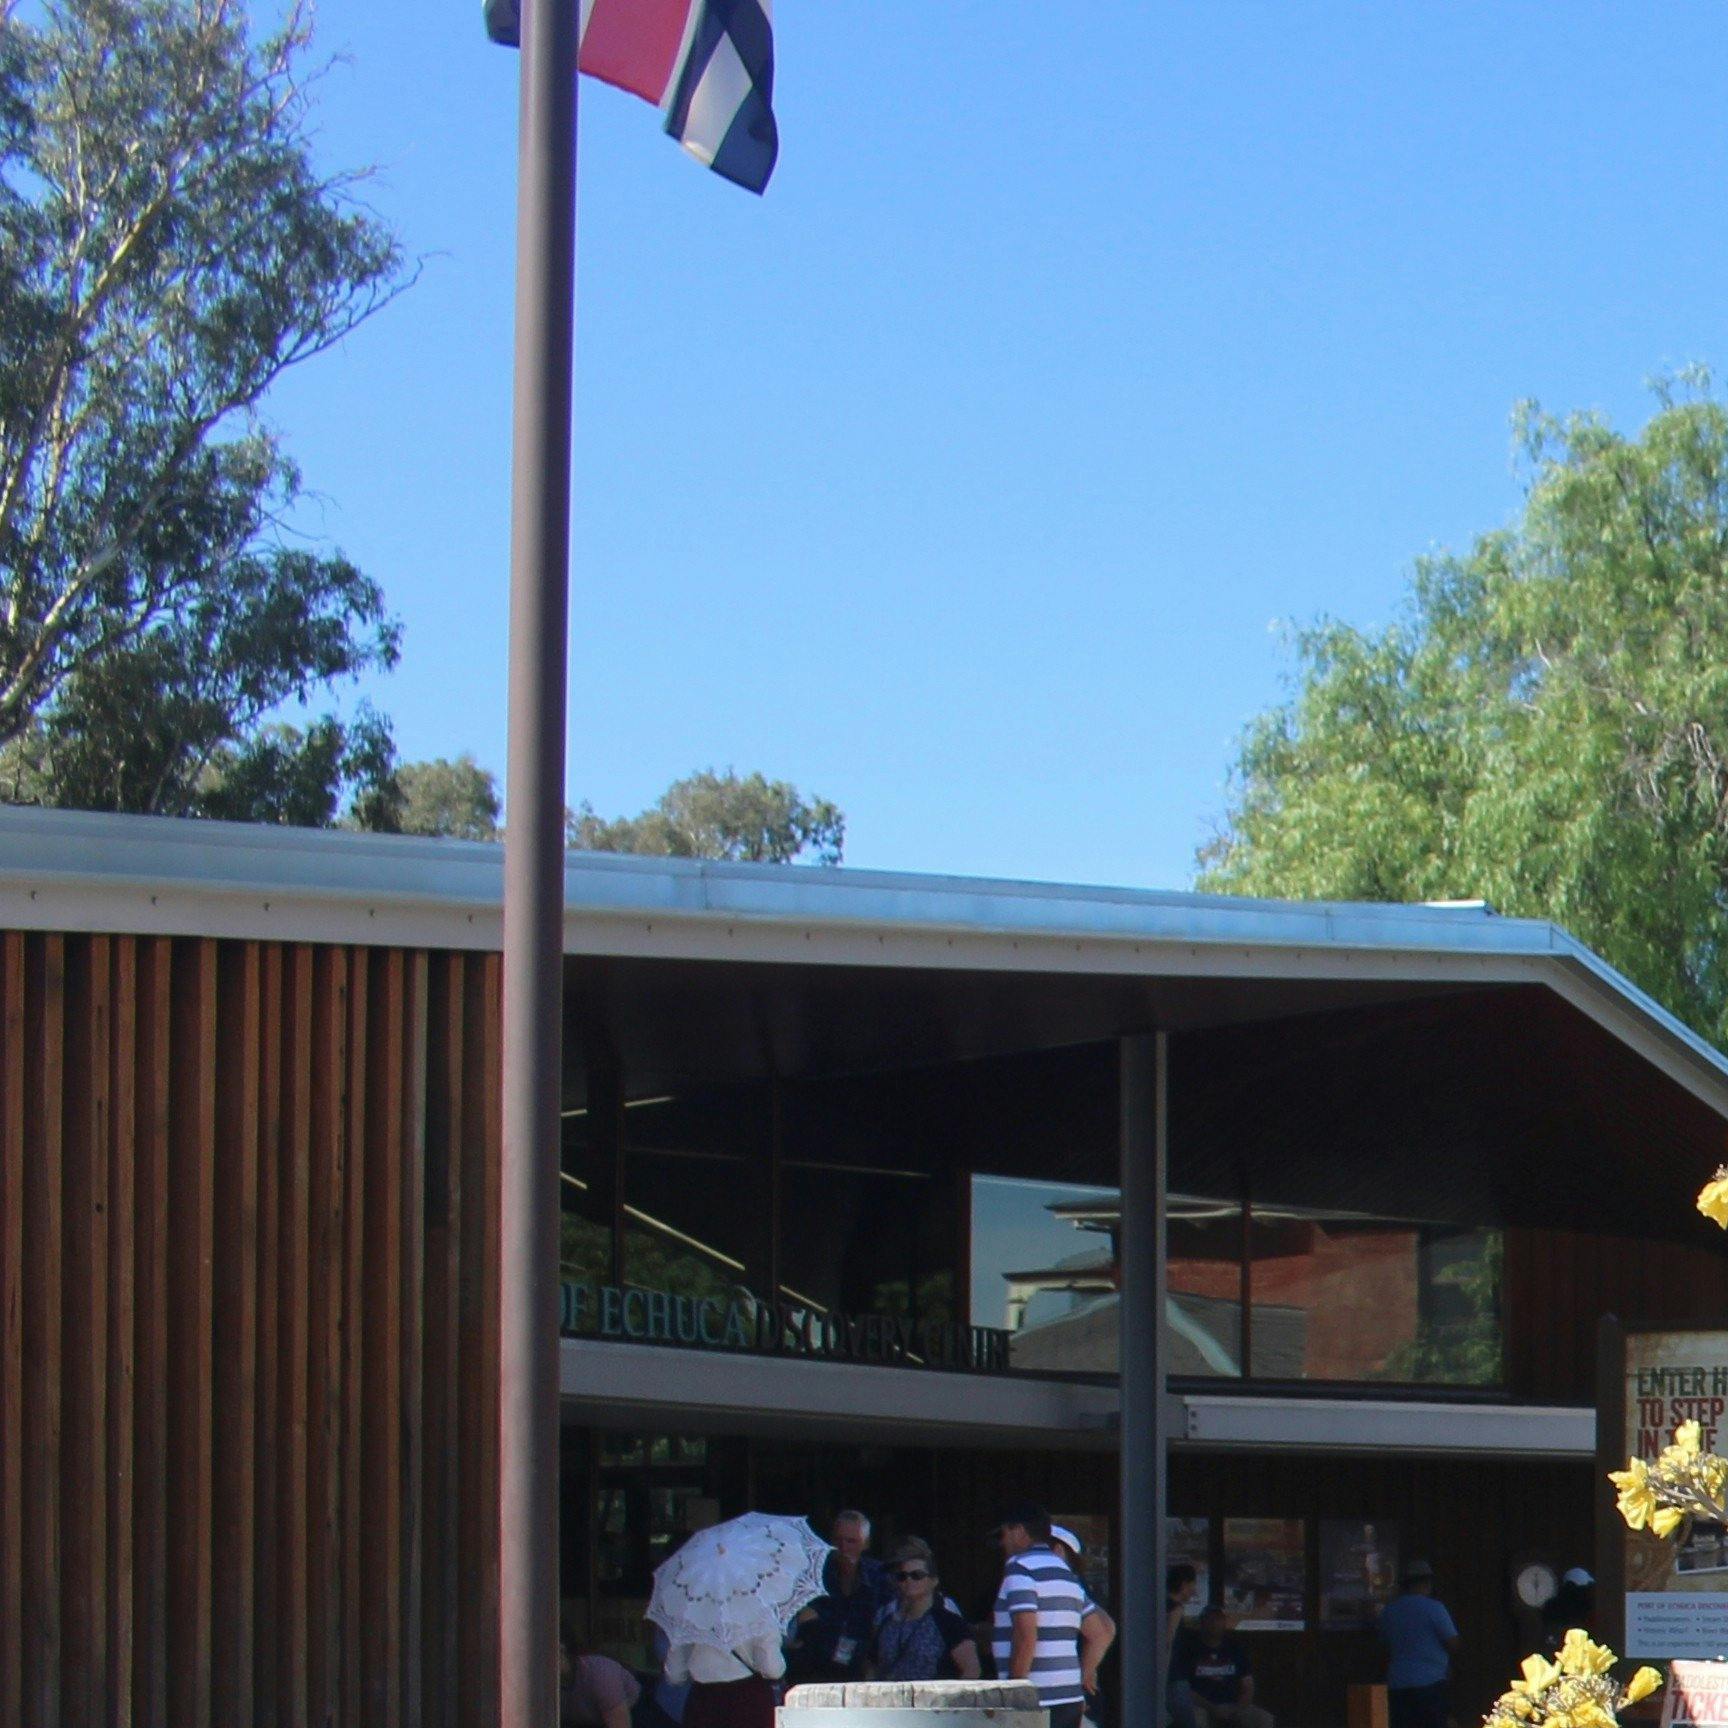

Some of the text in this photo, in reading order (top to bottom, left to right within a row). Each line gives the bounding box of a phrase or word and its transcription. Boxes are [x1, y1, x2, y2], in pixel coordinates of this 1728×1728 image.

[600, 1286, 749, 1346] ECHUCA
[1637, 1366, 1706, 1396] ENTER
[1636, 1398, 1664, 1427] TO
[1670, 1397, 1724, 1427] STEP
[1637, 1429, 1660, 1458] IN
